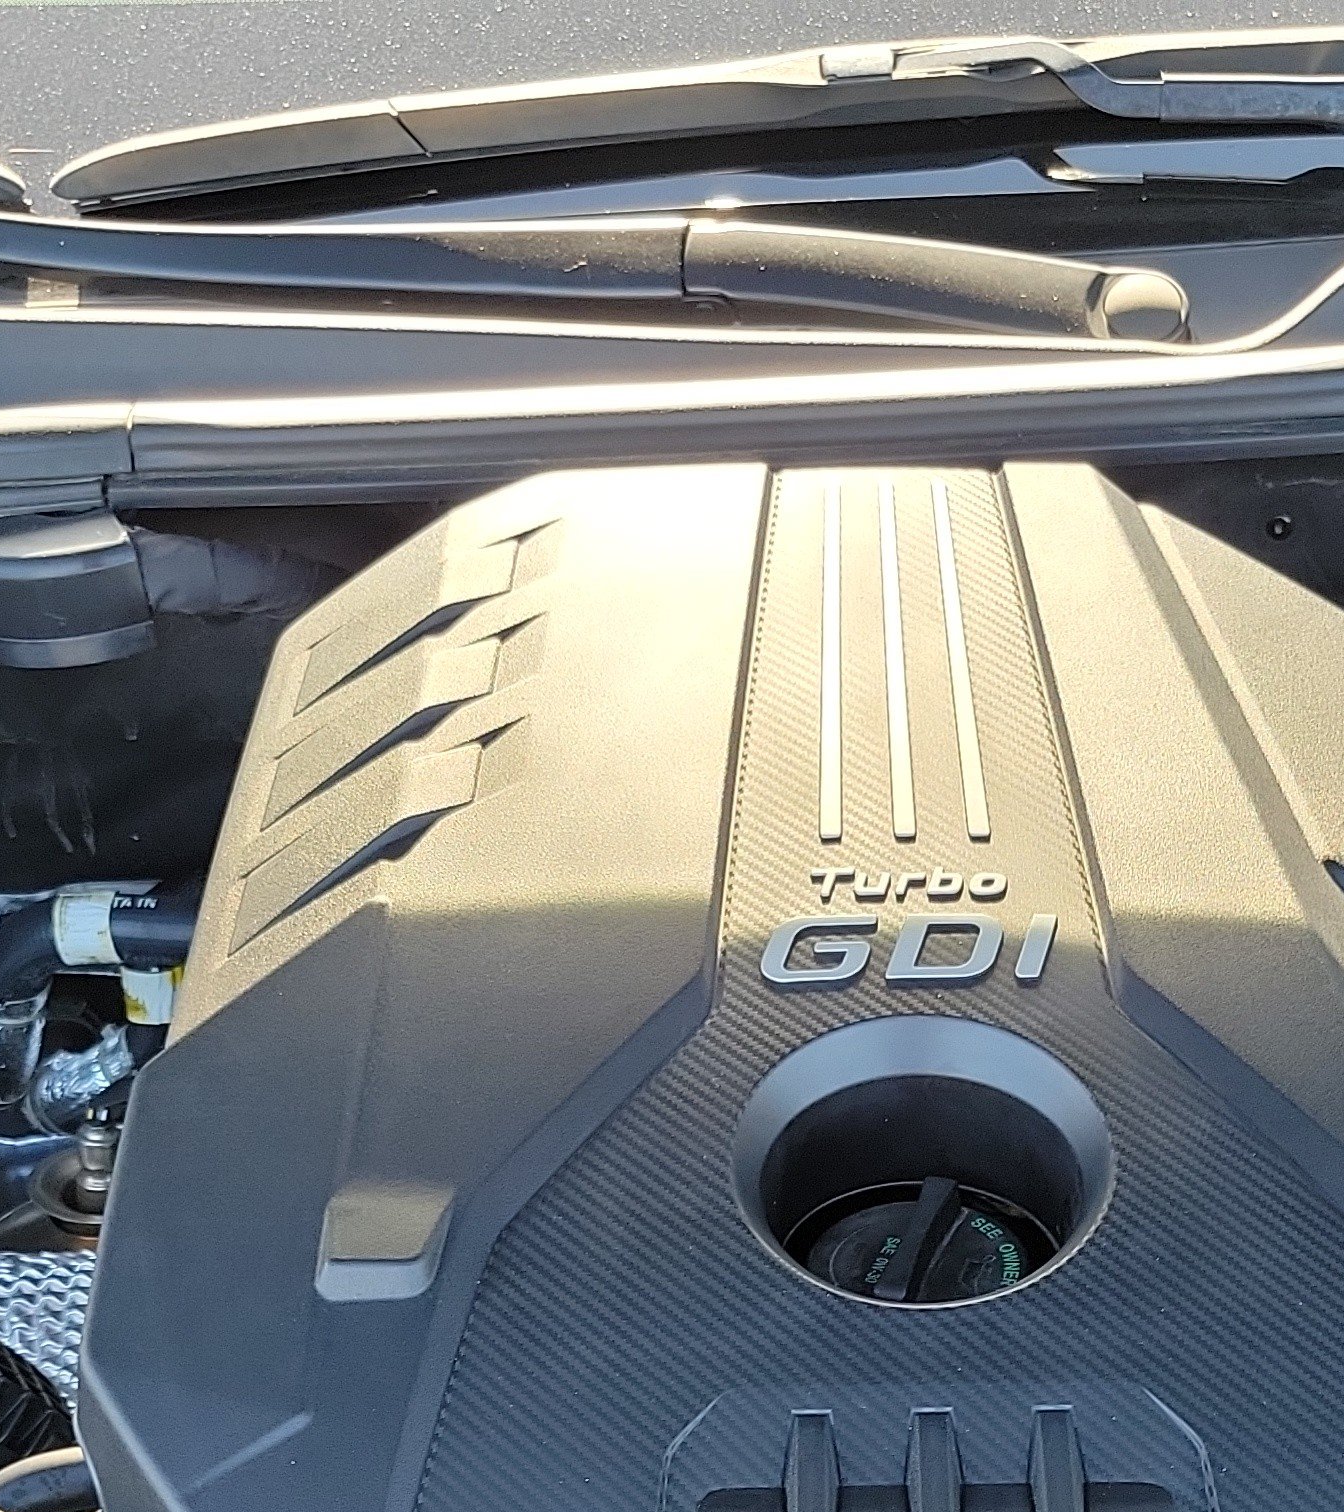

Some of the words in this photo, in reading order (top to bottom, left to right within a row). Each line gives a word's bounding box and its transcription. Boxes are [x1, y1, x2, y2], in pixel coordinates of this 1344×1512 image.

[811, 867, 1008, 898] Turbo
[760, 914, 1059, 984] GDI
[881, 1236, 902, 1257] SAE
[970, 1217, 1004, 1240] SEE
[998, 1243, 1021, 1287] OWNER
